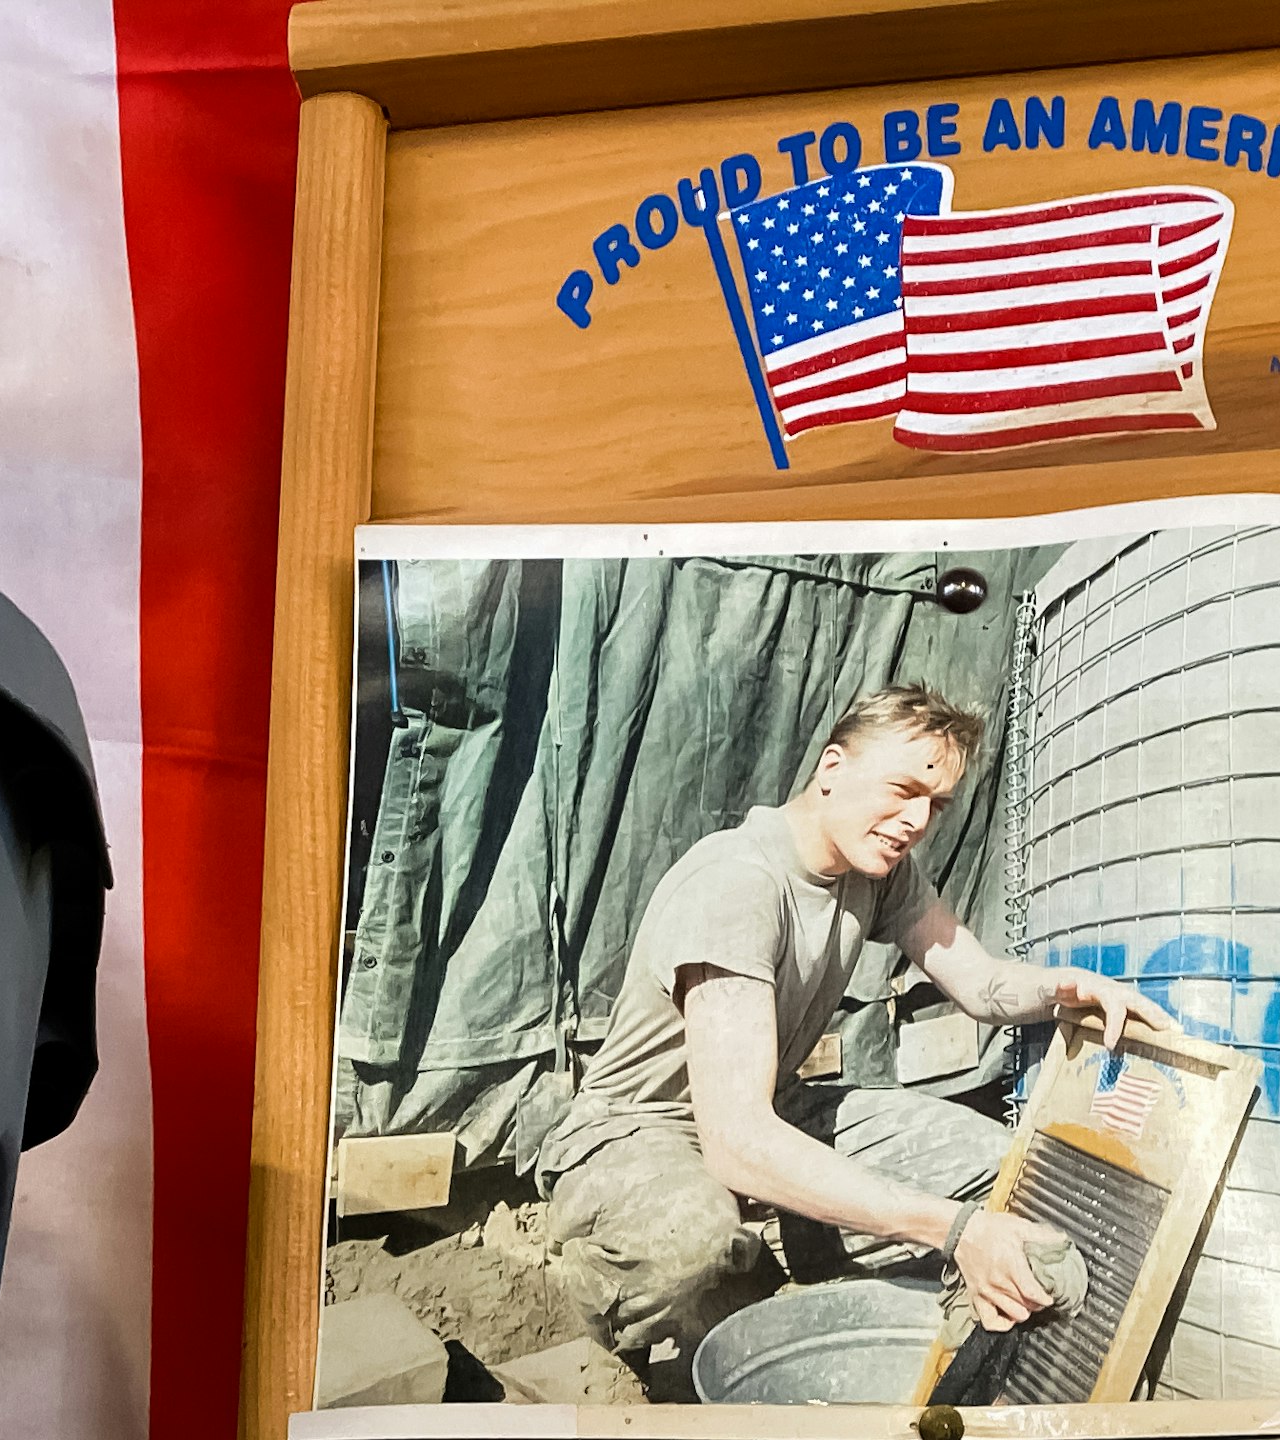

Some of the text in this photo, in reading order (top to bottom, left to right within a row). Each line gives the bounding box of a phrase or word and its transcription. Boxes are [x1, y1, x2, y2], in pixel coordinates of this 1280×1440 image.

[556, 150, 761, 329] PROUD
[777, 121, 863, 186] TO
[883, 102, 960, 162] BE
[982, 95, 1066, 152] AN
